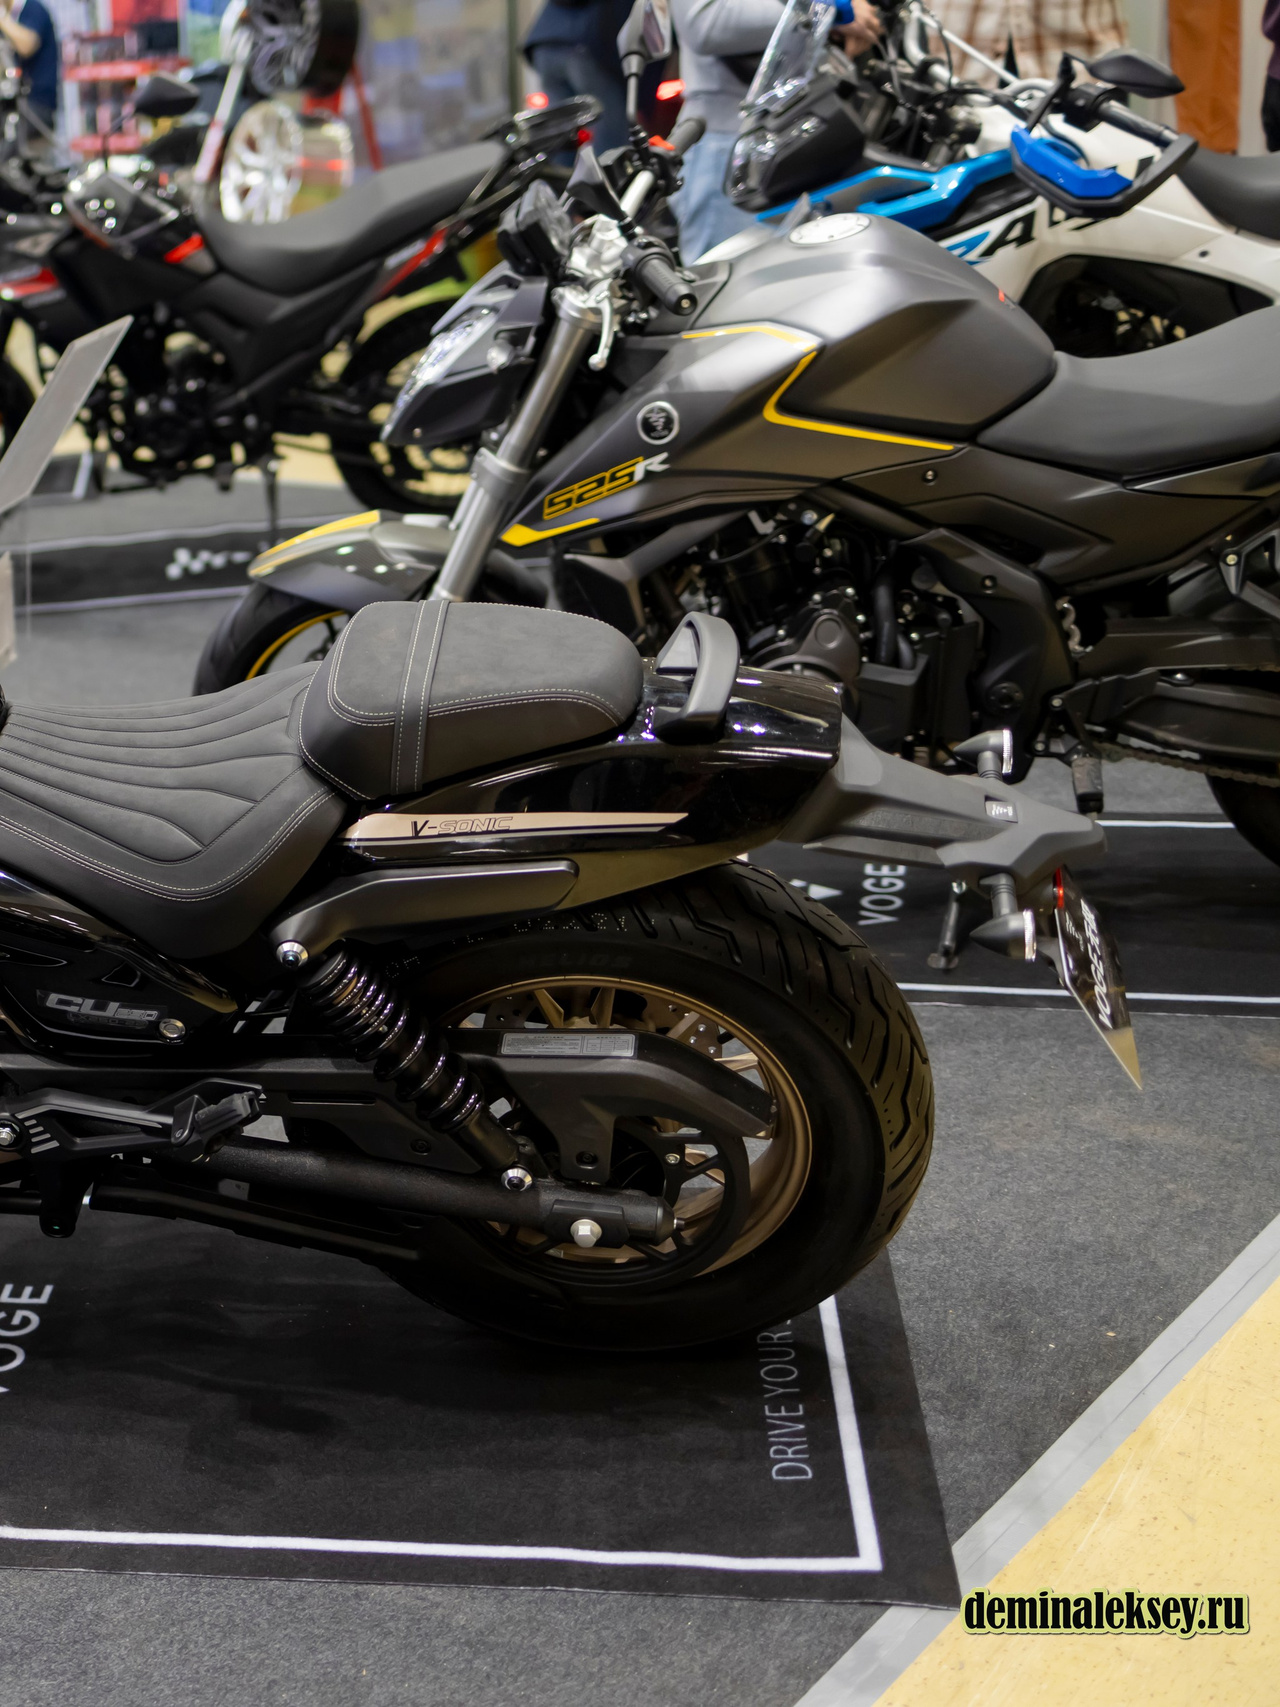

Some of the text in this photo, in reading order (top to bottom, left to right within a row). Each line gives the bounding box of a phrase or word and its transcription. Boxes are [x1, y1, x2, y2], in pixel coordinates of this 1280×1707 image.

[411, 816, 514, 837] V-SONIC
[857, 863, 907, 926] VOGE
[757, 1331, 813, 1480] DRIVE YOUR
